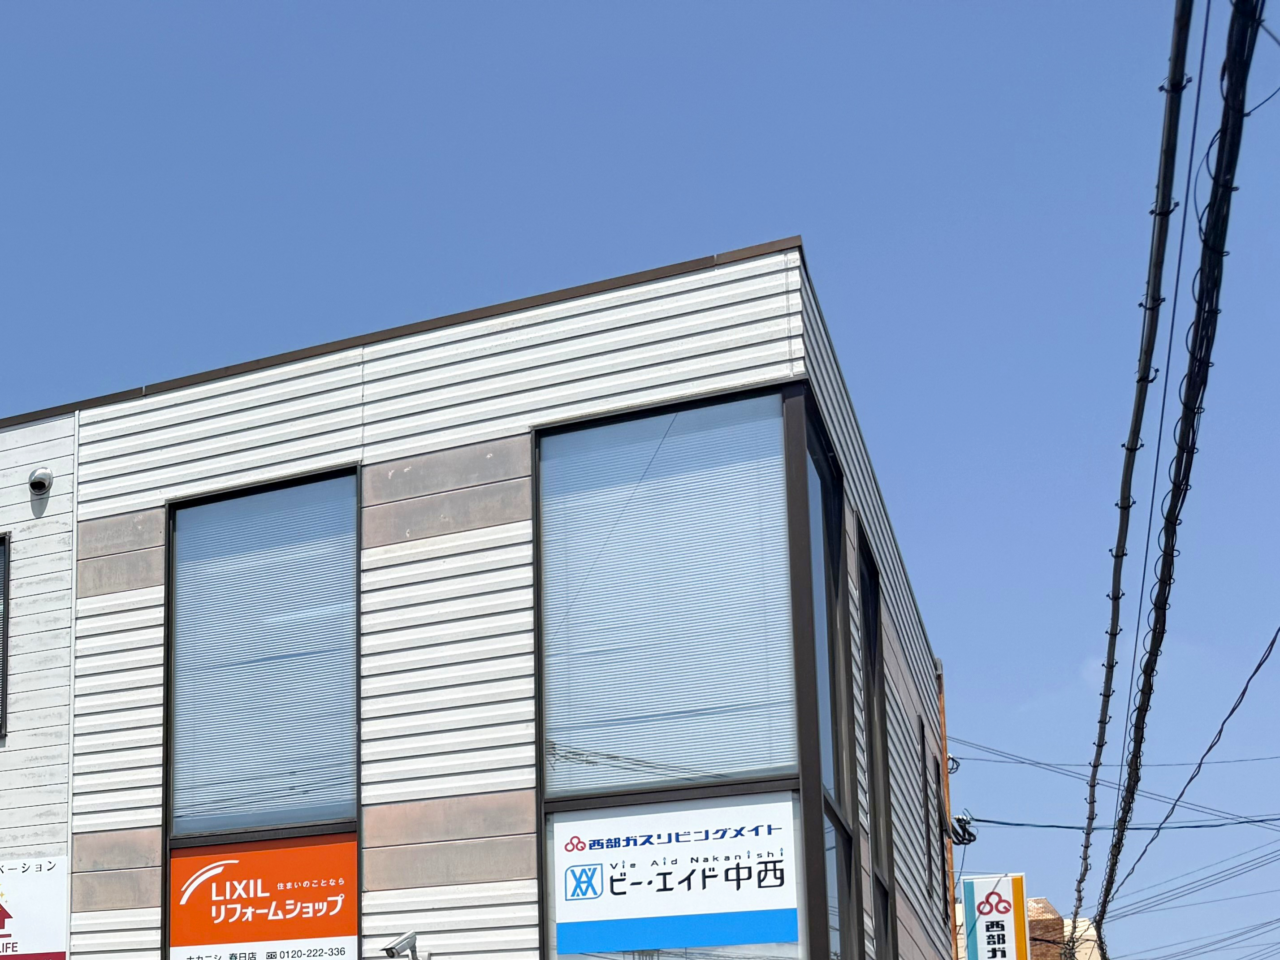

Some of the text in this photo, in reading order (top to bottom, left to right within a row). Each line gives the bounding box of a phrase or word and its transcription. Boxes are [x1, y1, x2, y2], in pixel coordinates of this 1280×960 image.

[588, 824, 783, 851] 西部ガスリビングメイト
[610, 847, 784, 870] Vie Aid Nakanishi
[277, 877, 345, 890] 住まいのことなら
[609, 859, 785, 896] ビー・エイド中西
[211, 878, 270, 901] LIXIL
[211, 893, 345, 924] リフォームショップ
[279, 947, 346, 959] 0120-222-336
